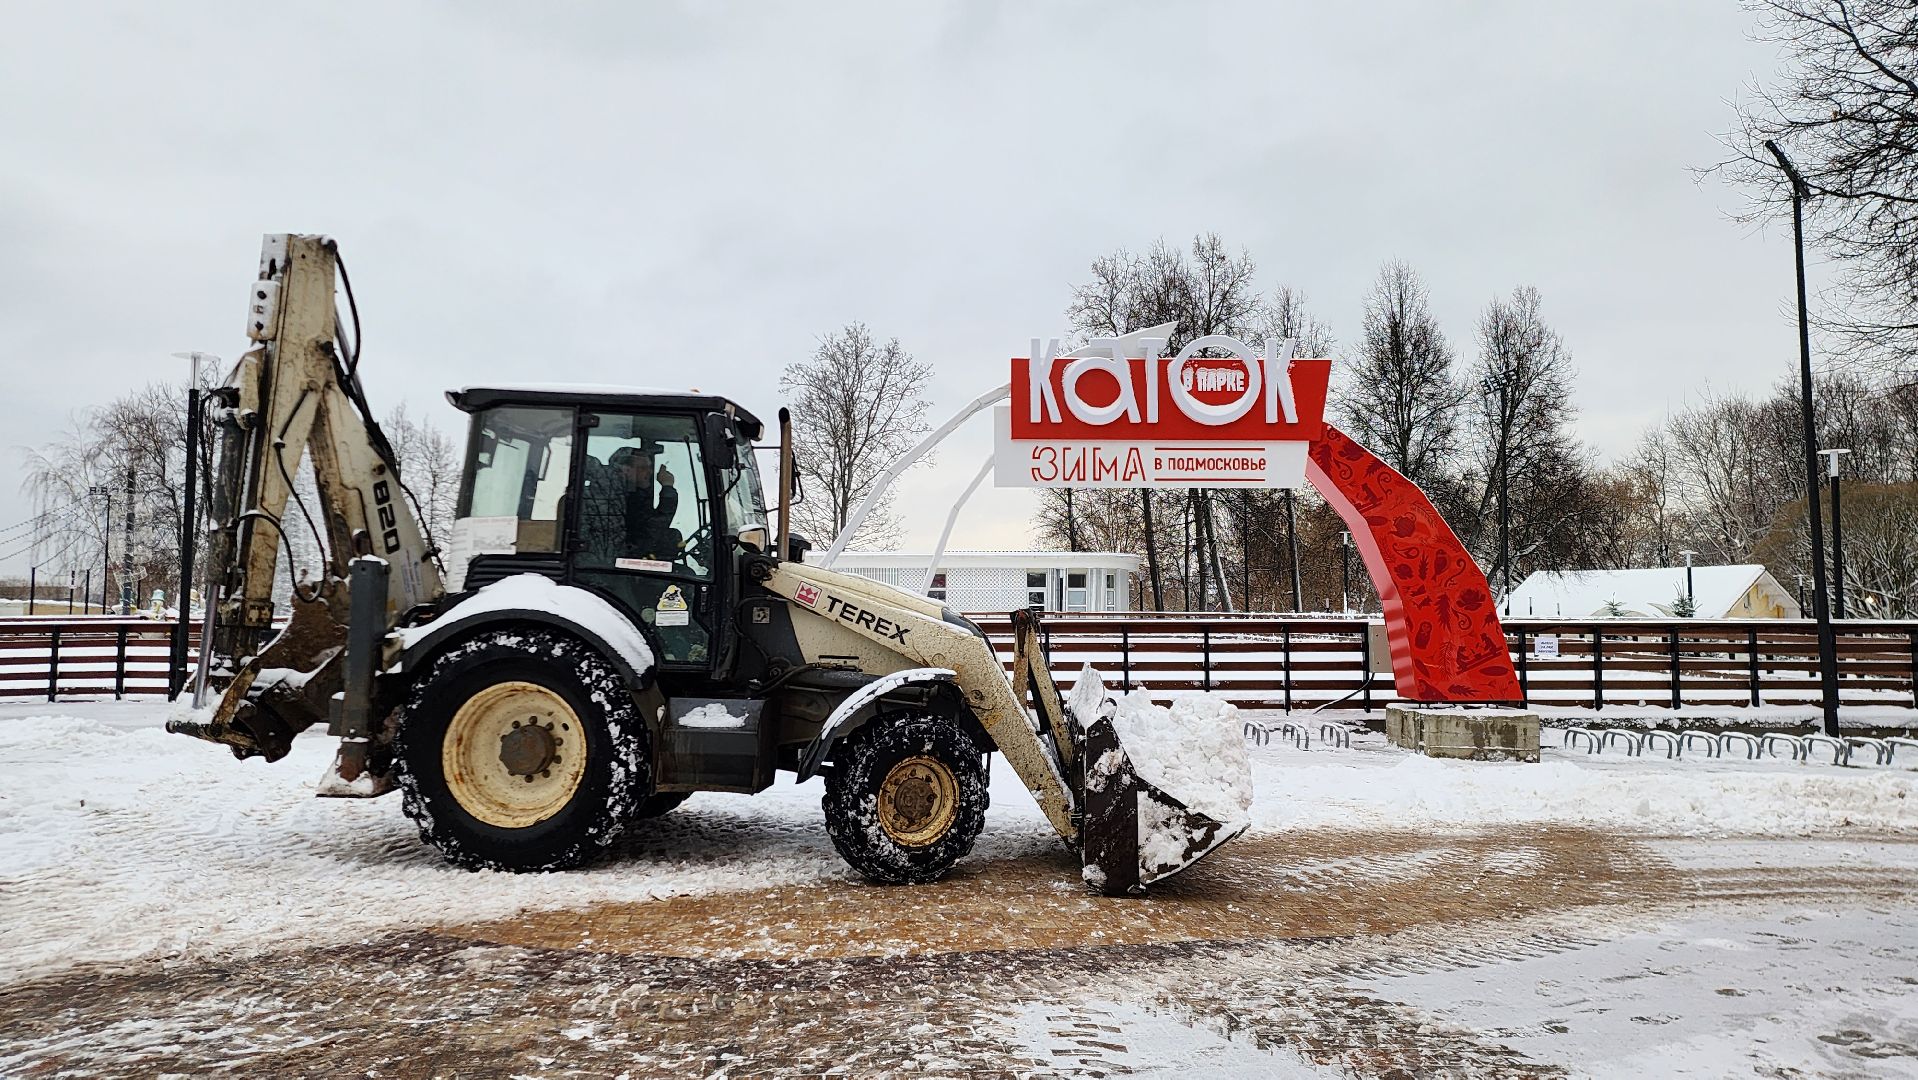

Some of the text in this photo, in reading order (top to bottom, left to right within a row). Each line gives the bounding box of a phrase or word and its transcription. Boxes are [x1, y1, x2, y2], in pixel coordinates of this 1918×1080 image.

[1196, 368, 1245, 392] ПАРКЕ
[1031, 446, 1146, 482] ЗИМА
[373, 480, 400, 555] 820
[826, 595, 911, 645] TEREX
